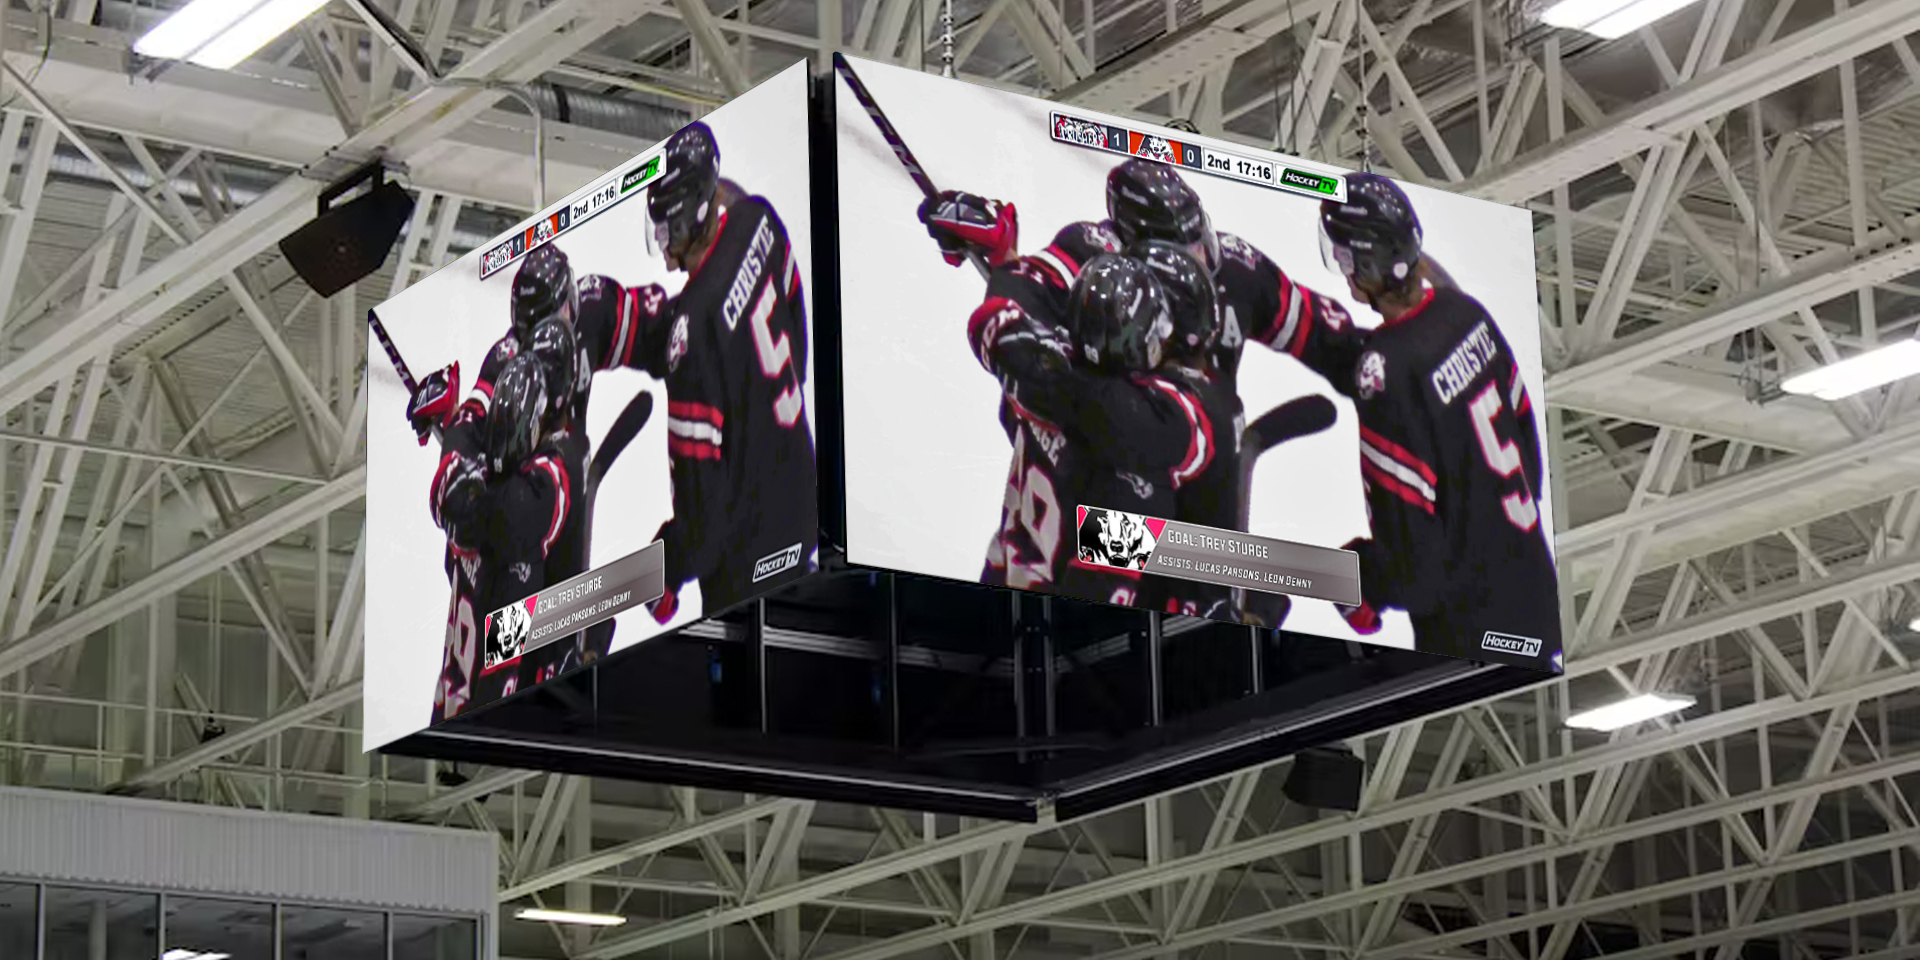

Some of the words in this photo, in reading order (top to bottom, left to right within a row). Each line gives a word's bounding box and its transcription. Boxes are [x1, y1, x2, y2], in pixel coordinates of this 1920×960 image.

[1113, 132, 1121, 149] 1
[1186, 149, 1195, 163] 0
[1207, 154, 1231, 171] 2nd
[1236, 161, 1272, 180] 17:16
[560, 213, 566, 227] 0
[573, 200, 589, 220] 2nd
[592, 186, 615, 209] 17:16
[516, 239, 522, 252] 1
[722, 213, 775, 331] CHRISTIE
[750, 272, 803, 428] 5
[1432, 320, 1498, 404] CHRISTIE
[1468, 378, 1539, 533] 5
[1167, 529, 1198, 548] GOAL:
[1199, 533, 1226, 552] TREY
[1227, 538, 1269, 559] STURGE
[1156, 554, 1193, 570] ASSISTS:
[1195, 559, 1221, 575] LUCAS
[1222, 565, 1262, 582] PARSONS,
[1263, 572, 1284, 585] LEON
[1286, 575, 1313, 590] DENNY
[538, 600, 557, 615] GOAL:
[557, 586, 576, 607] TREY
[576, 575, 603, 598] STURGE
[530, 622, 554, 641] ASSISTS:
[554, 617, 571, 632] LUCAS
[571, 608, 597, 627] PARSONS,
[598, 600, 612, 614] LEON
[613, 590, 632, 607] DENNY
